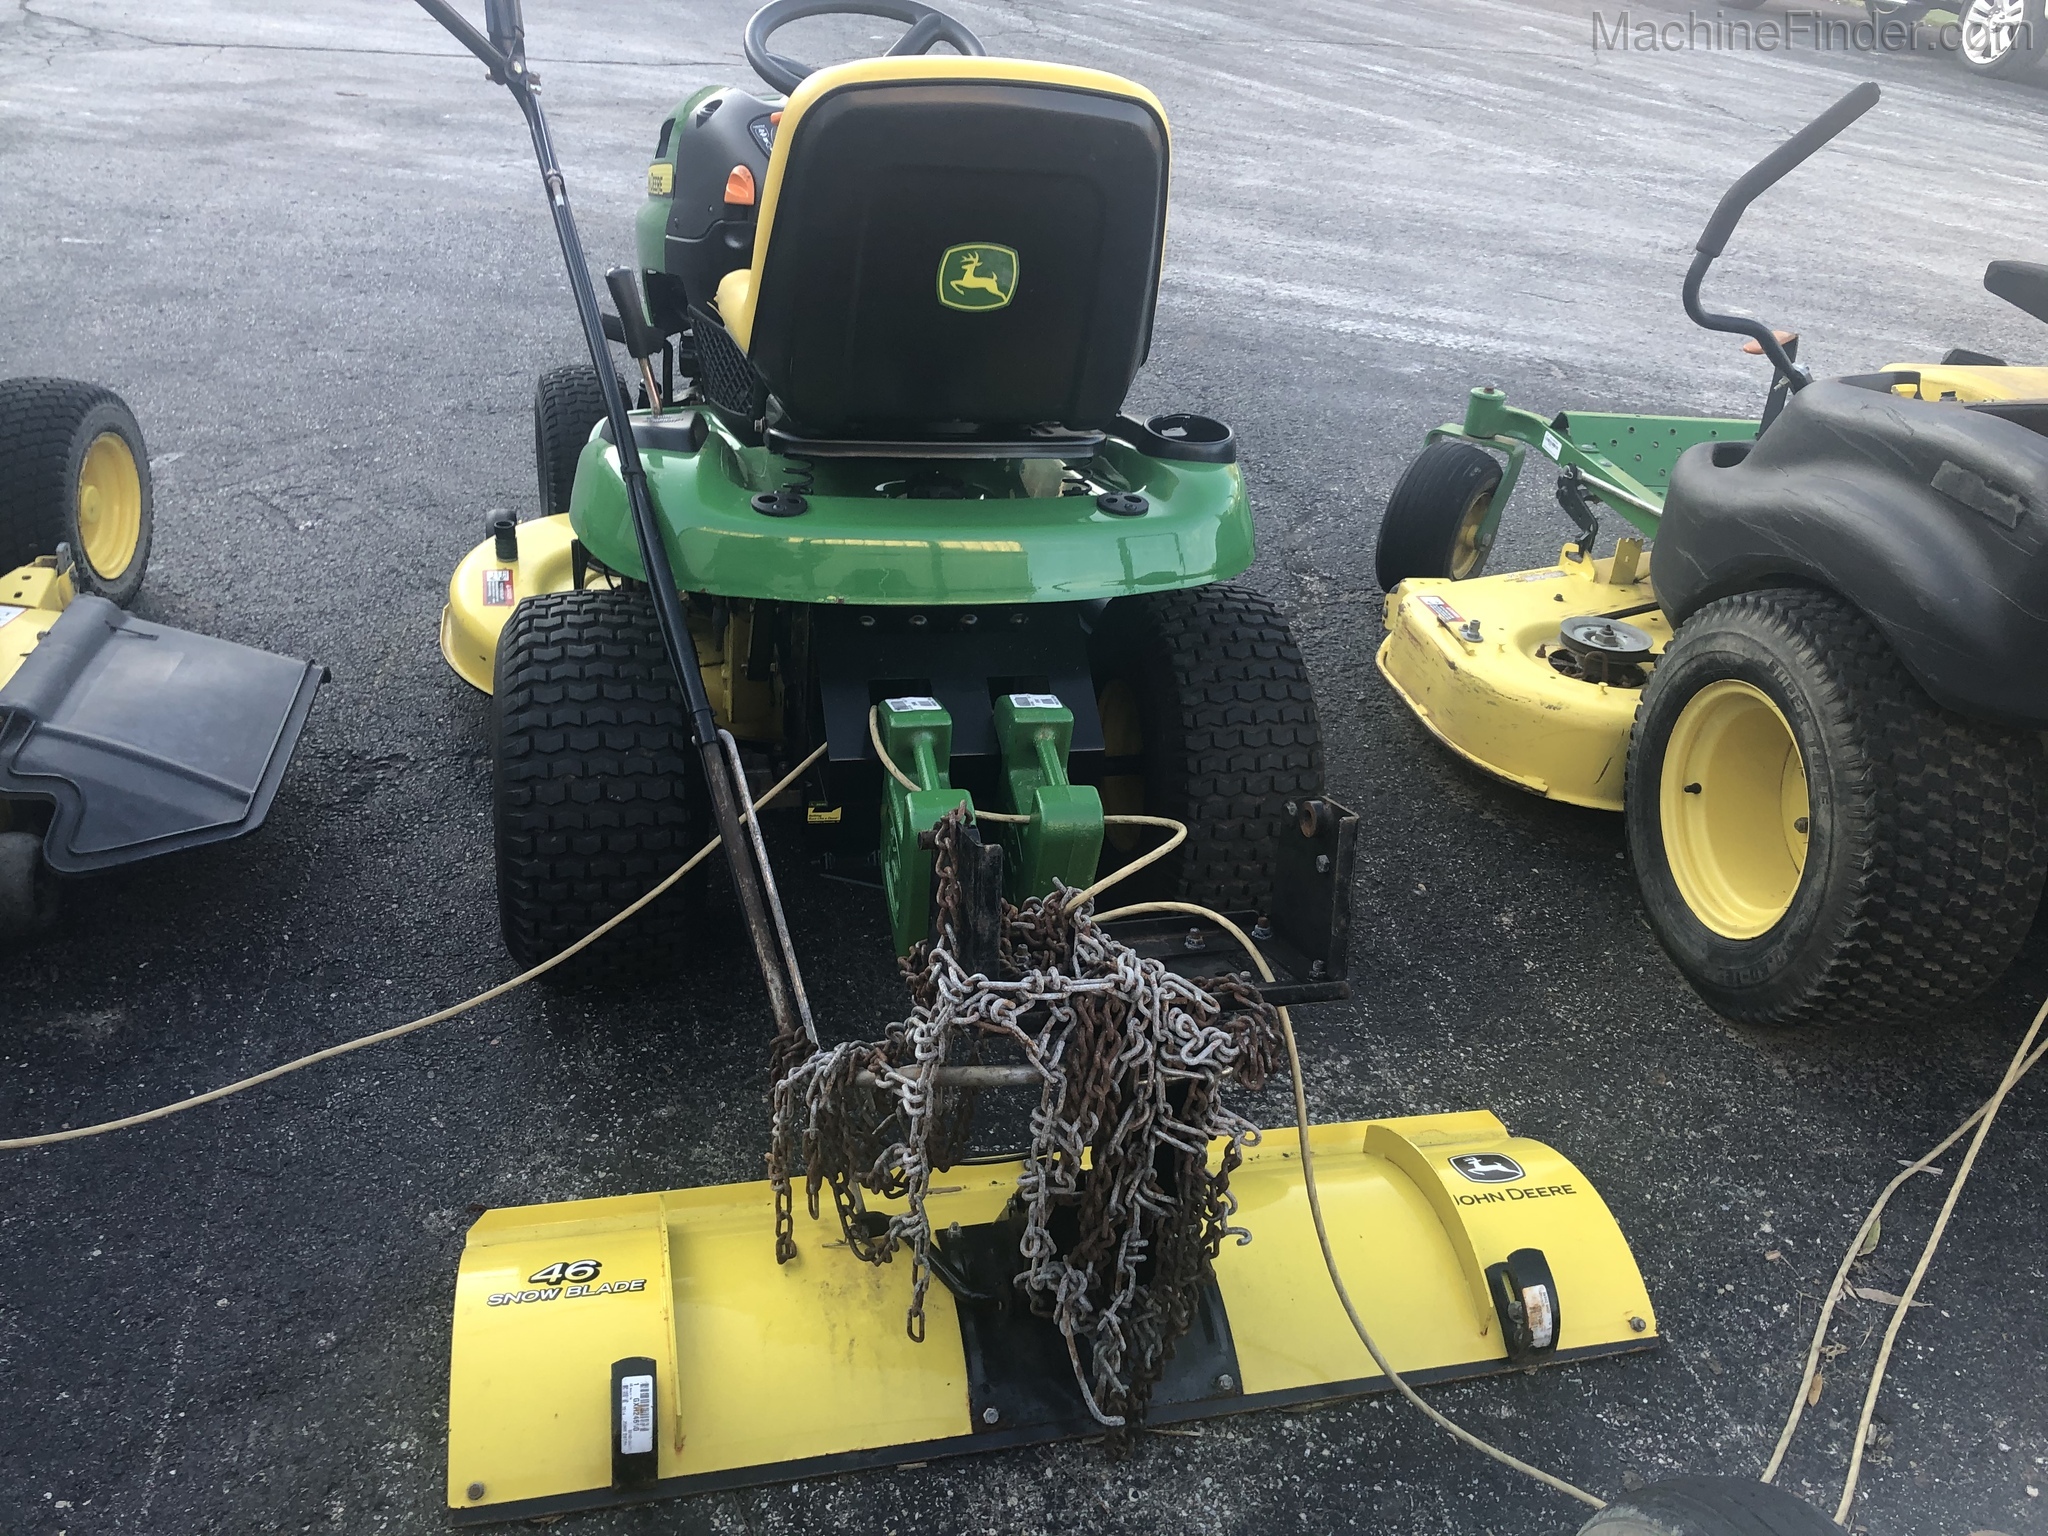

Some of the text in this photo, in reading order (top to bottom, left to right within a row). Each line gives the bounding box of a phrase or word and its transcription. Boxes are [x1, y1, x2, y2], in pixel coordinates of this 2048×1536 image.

[1505, 1184, 1577, 1201] DEERE
[528, 1259, 603, 1285] 46
[487, 1279, 647, 1306] SNOW BLADE
